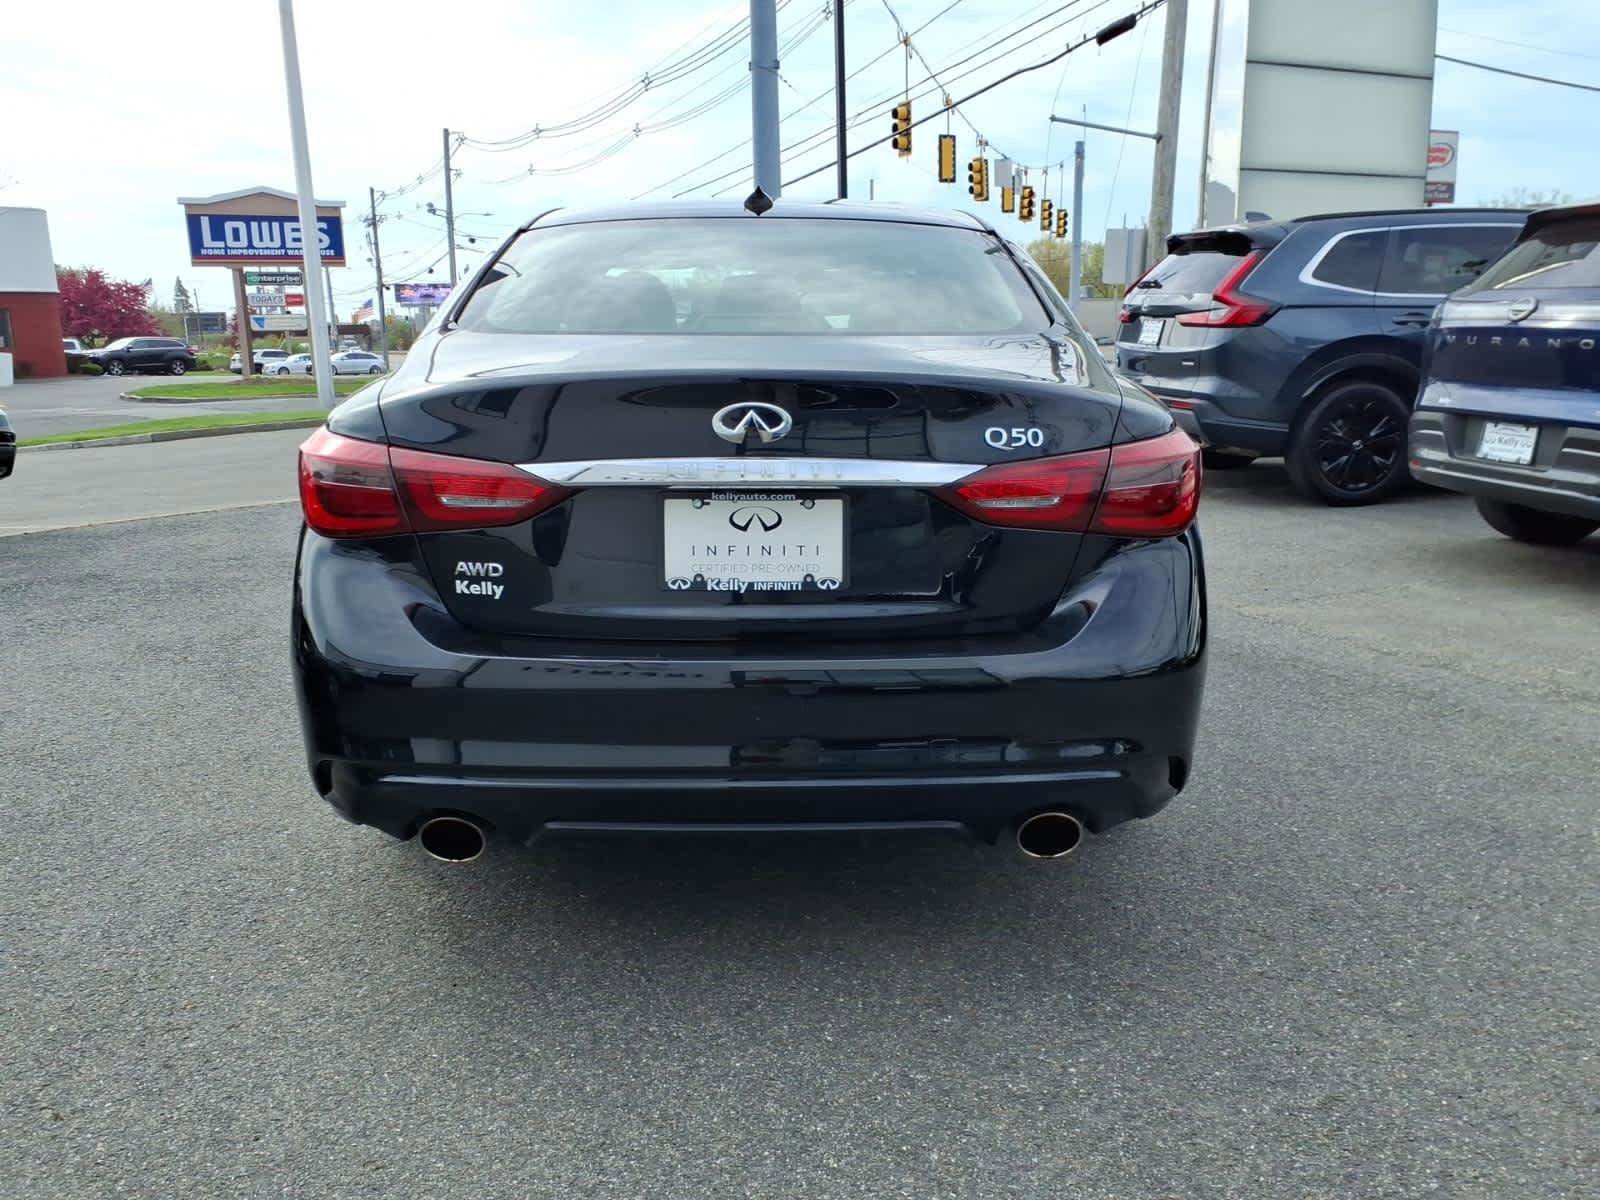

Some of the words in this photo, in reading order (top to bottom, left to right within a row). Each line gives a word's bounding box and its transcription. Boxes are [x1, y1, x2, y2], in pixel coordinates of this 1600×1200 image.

[200, 216, 330, 249] LOWES
[250, 274, 299, 283] enterprise
[984, 427, 1044, 450] Q50
[711, 492, 796, 503] kellyauto.com
[691, 545, 821, 556] INFINITI
[454, 561, 504, 577] AWD
[691, 563, 749, 574] CERTIFIED
[752, 563, 821, 574] PRE-OWNED
[455, 579, 505, 600] Kelly
[706, 578, 749, 594] Kelly
[753, 582, 802, 591] INFINITI
